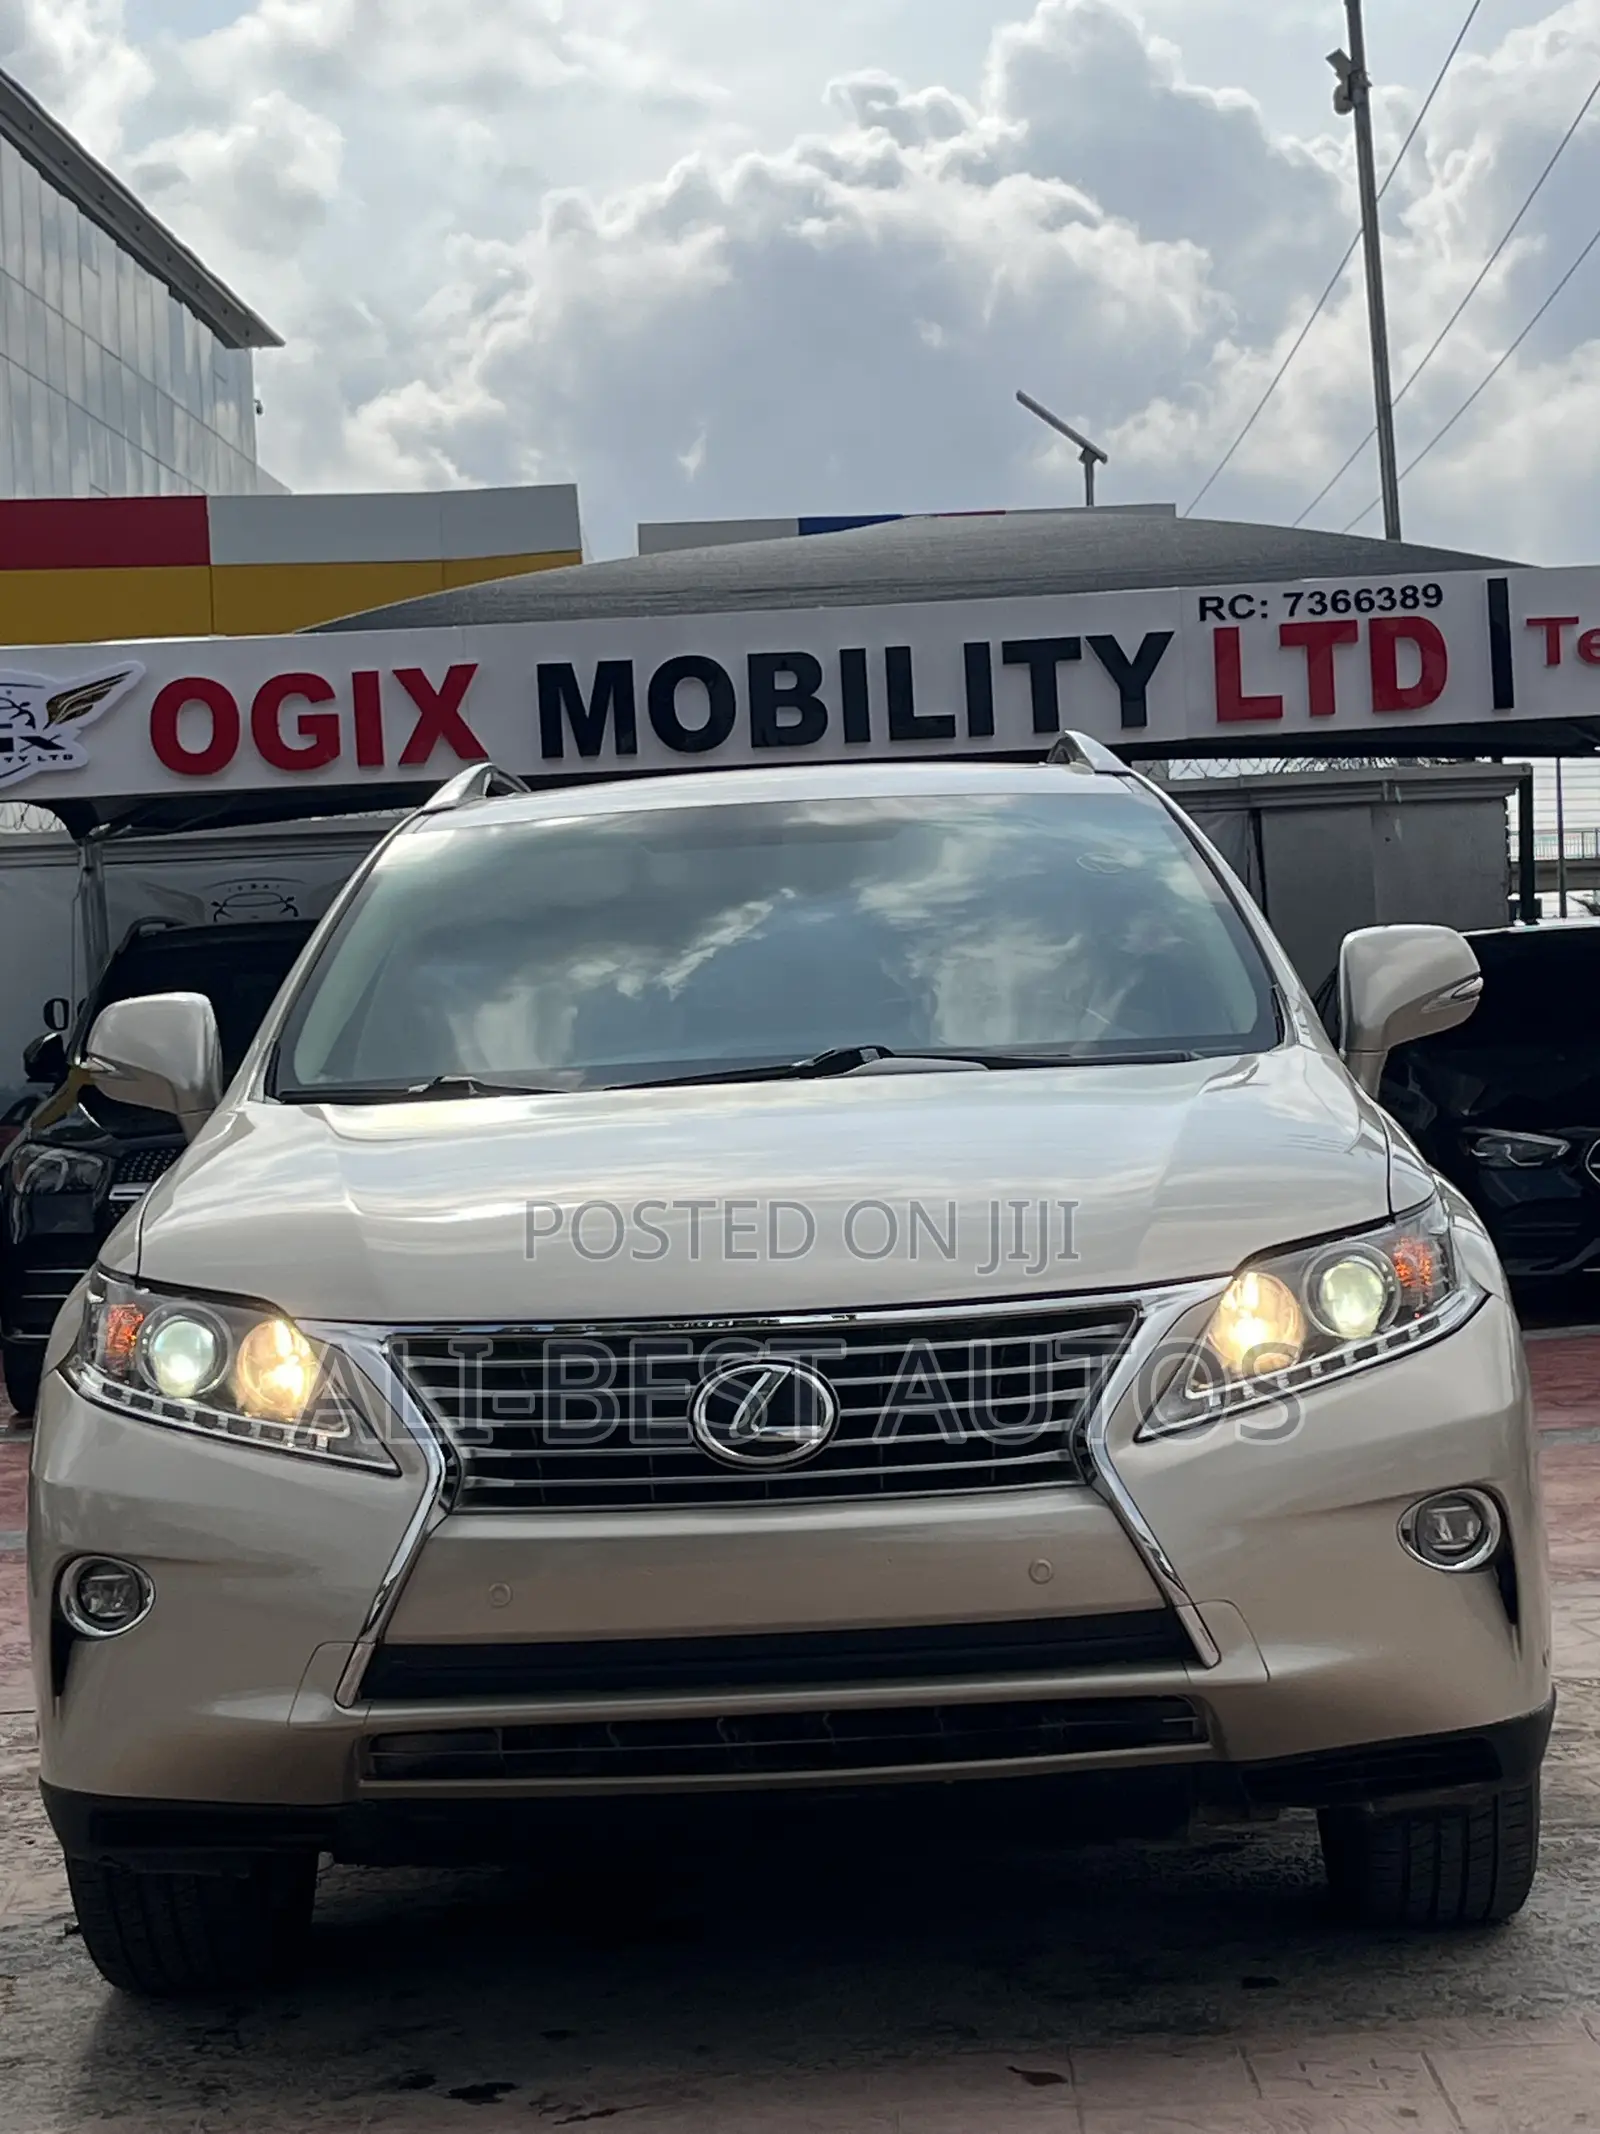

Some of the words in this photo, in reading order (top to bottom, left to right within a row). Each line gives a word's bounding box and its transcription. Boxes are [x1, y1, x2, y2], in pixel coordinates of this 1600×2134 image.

[1199, 593, 1268, 622] RC:
[1282, 583, 1443, 617] 7366389
[149, 664, 489, 776] OGIX
[537, 631, 1174, 759] MOBILITY
[1214, 615, 1448, 723] LTD
